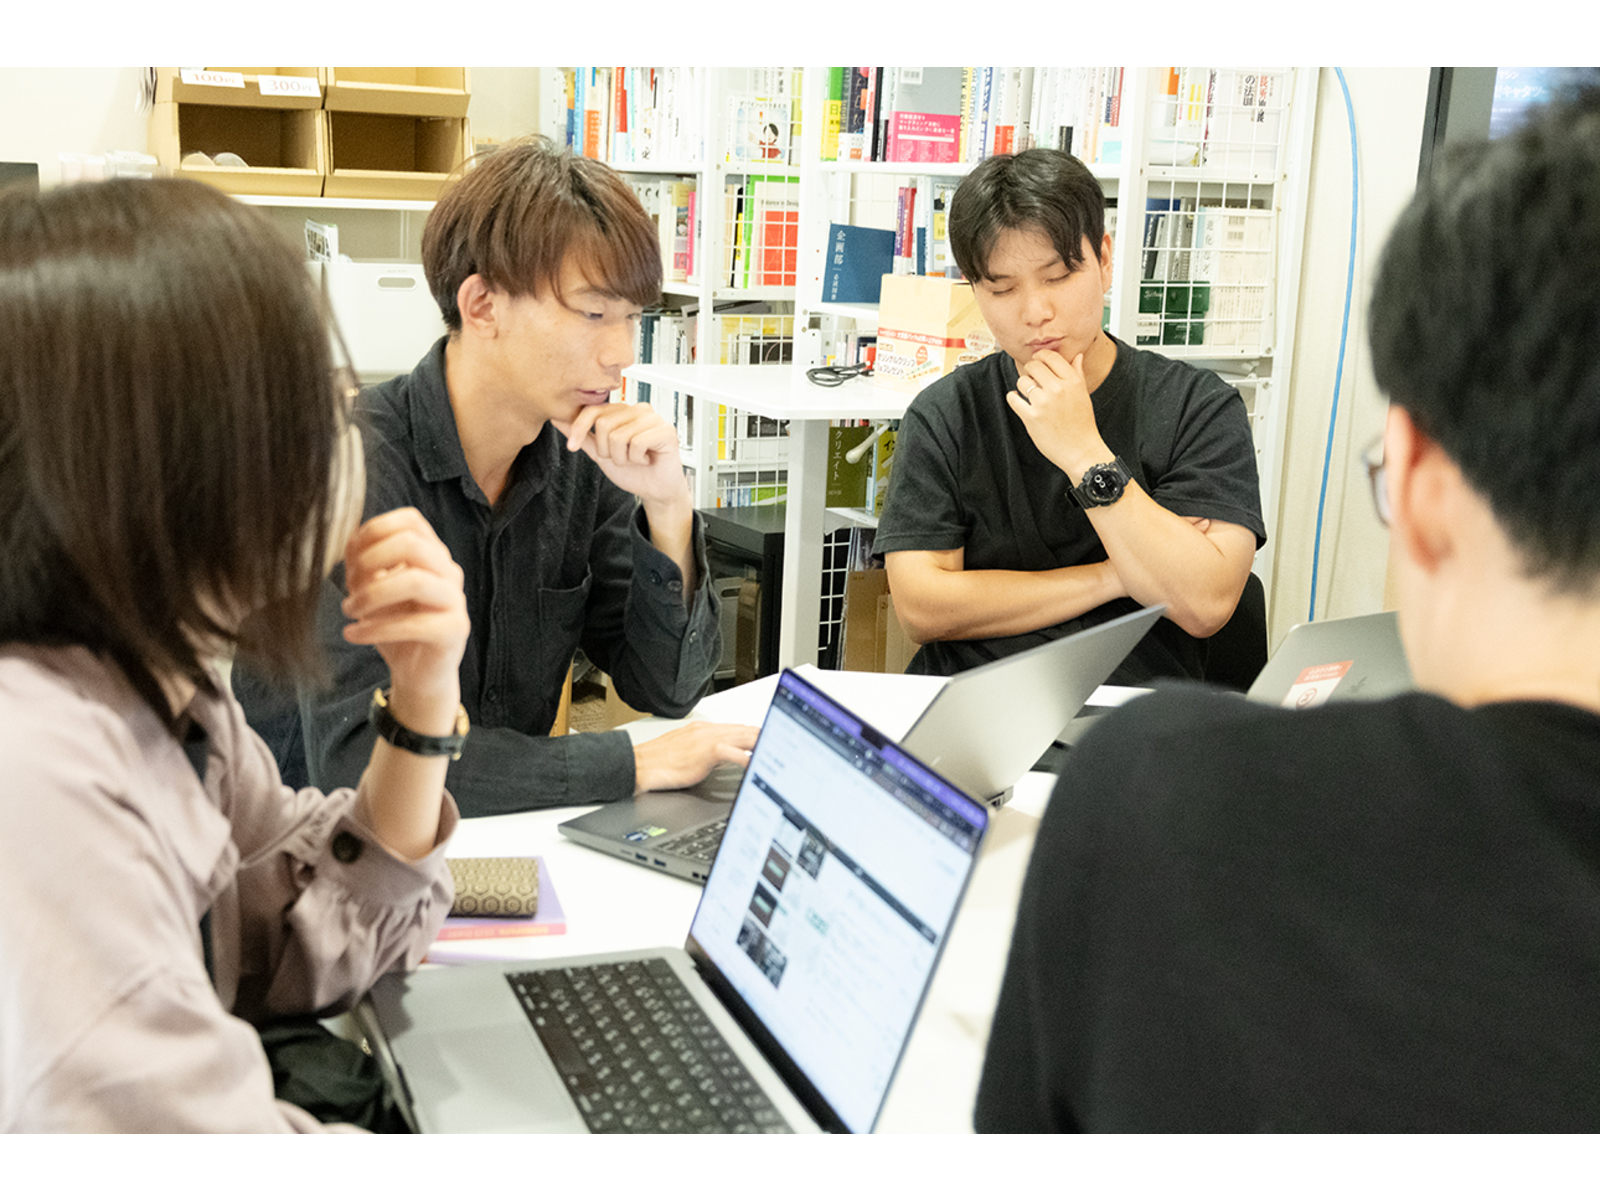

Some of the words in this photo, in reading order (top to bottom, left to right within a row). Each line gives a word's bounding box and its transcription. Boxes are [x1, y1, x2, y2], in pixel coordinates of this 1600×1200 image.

[968, 85, 977, 126] OUTPUT
[834, 231, 846, 266] 企画部
[833, 430, 843, 481] クリエイト
